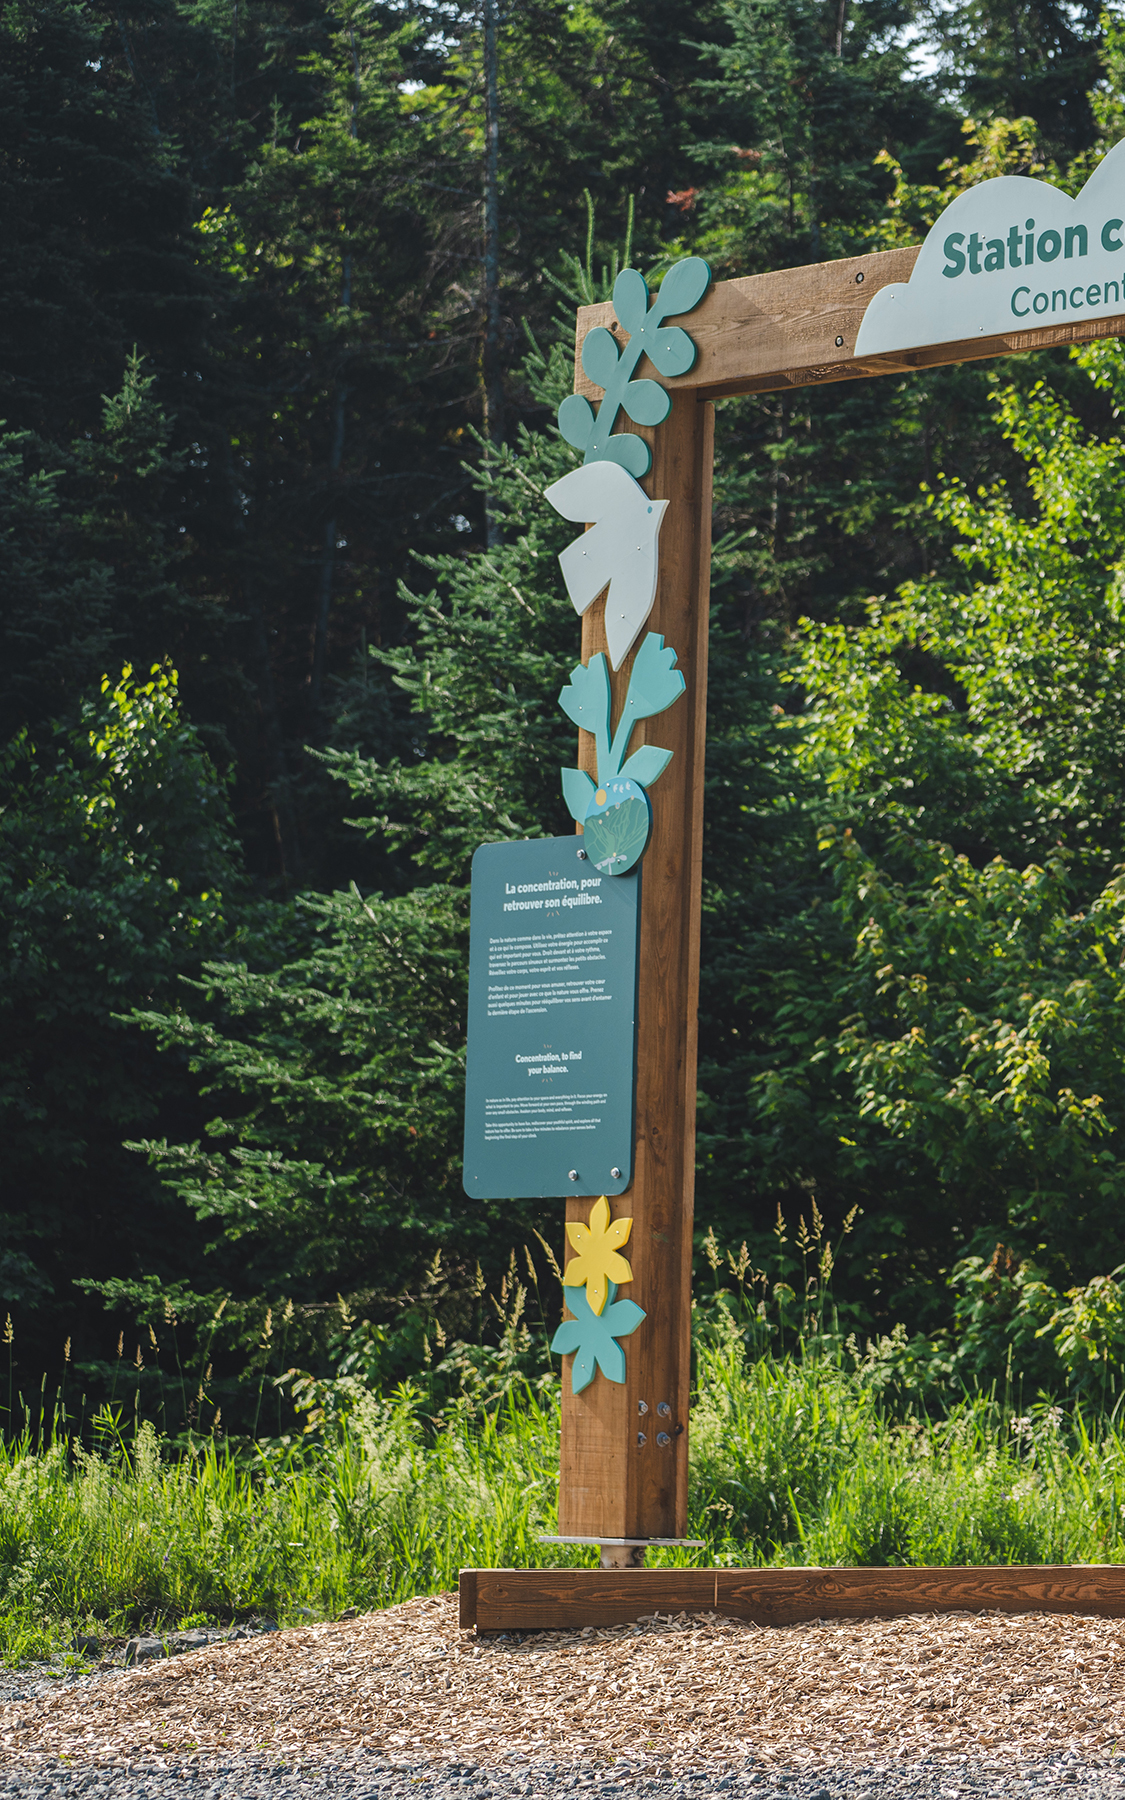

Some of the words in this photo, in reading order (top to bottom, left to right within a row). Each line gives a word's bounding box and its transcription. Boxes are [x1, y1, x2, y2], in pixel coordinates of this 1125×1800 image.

[941, 217, 1089, 279] Station
[506, 883, 516, 894] La
[517, 878, 580, 893] concentration,
[580, 878, 602, 890] pour
[504, 900, 544, 911] retrouver
[544, 899, 560, 908] son
[562, 893, 602, 908] équilibre.
[515, 1052, 560, 1063] Concentration,
[561, 1052, 568, 1060] to
[569, 1050, 582, 1060] find
[528, 1068, 542, 1076] your
[542, 1064, 568, 1074] balance.
